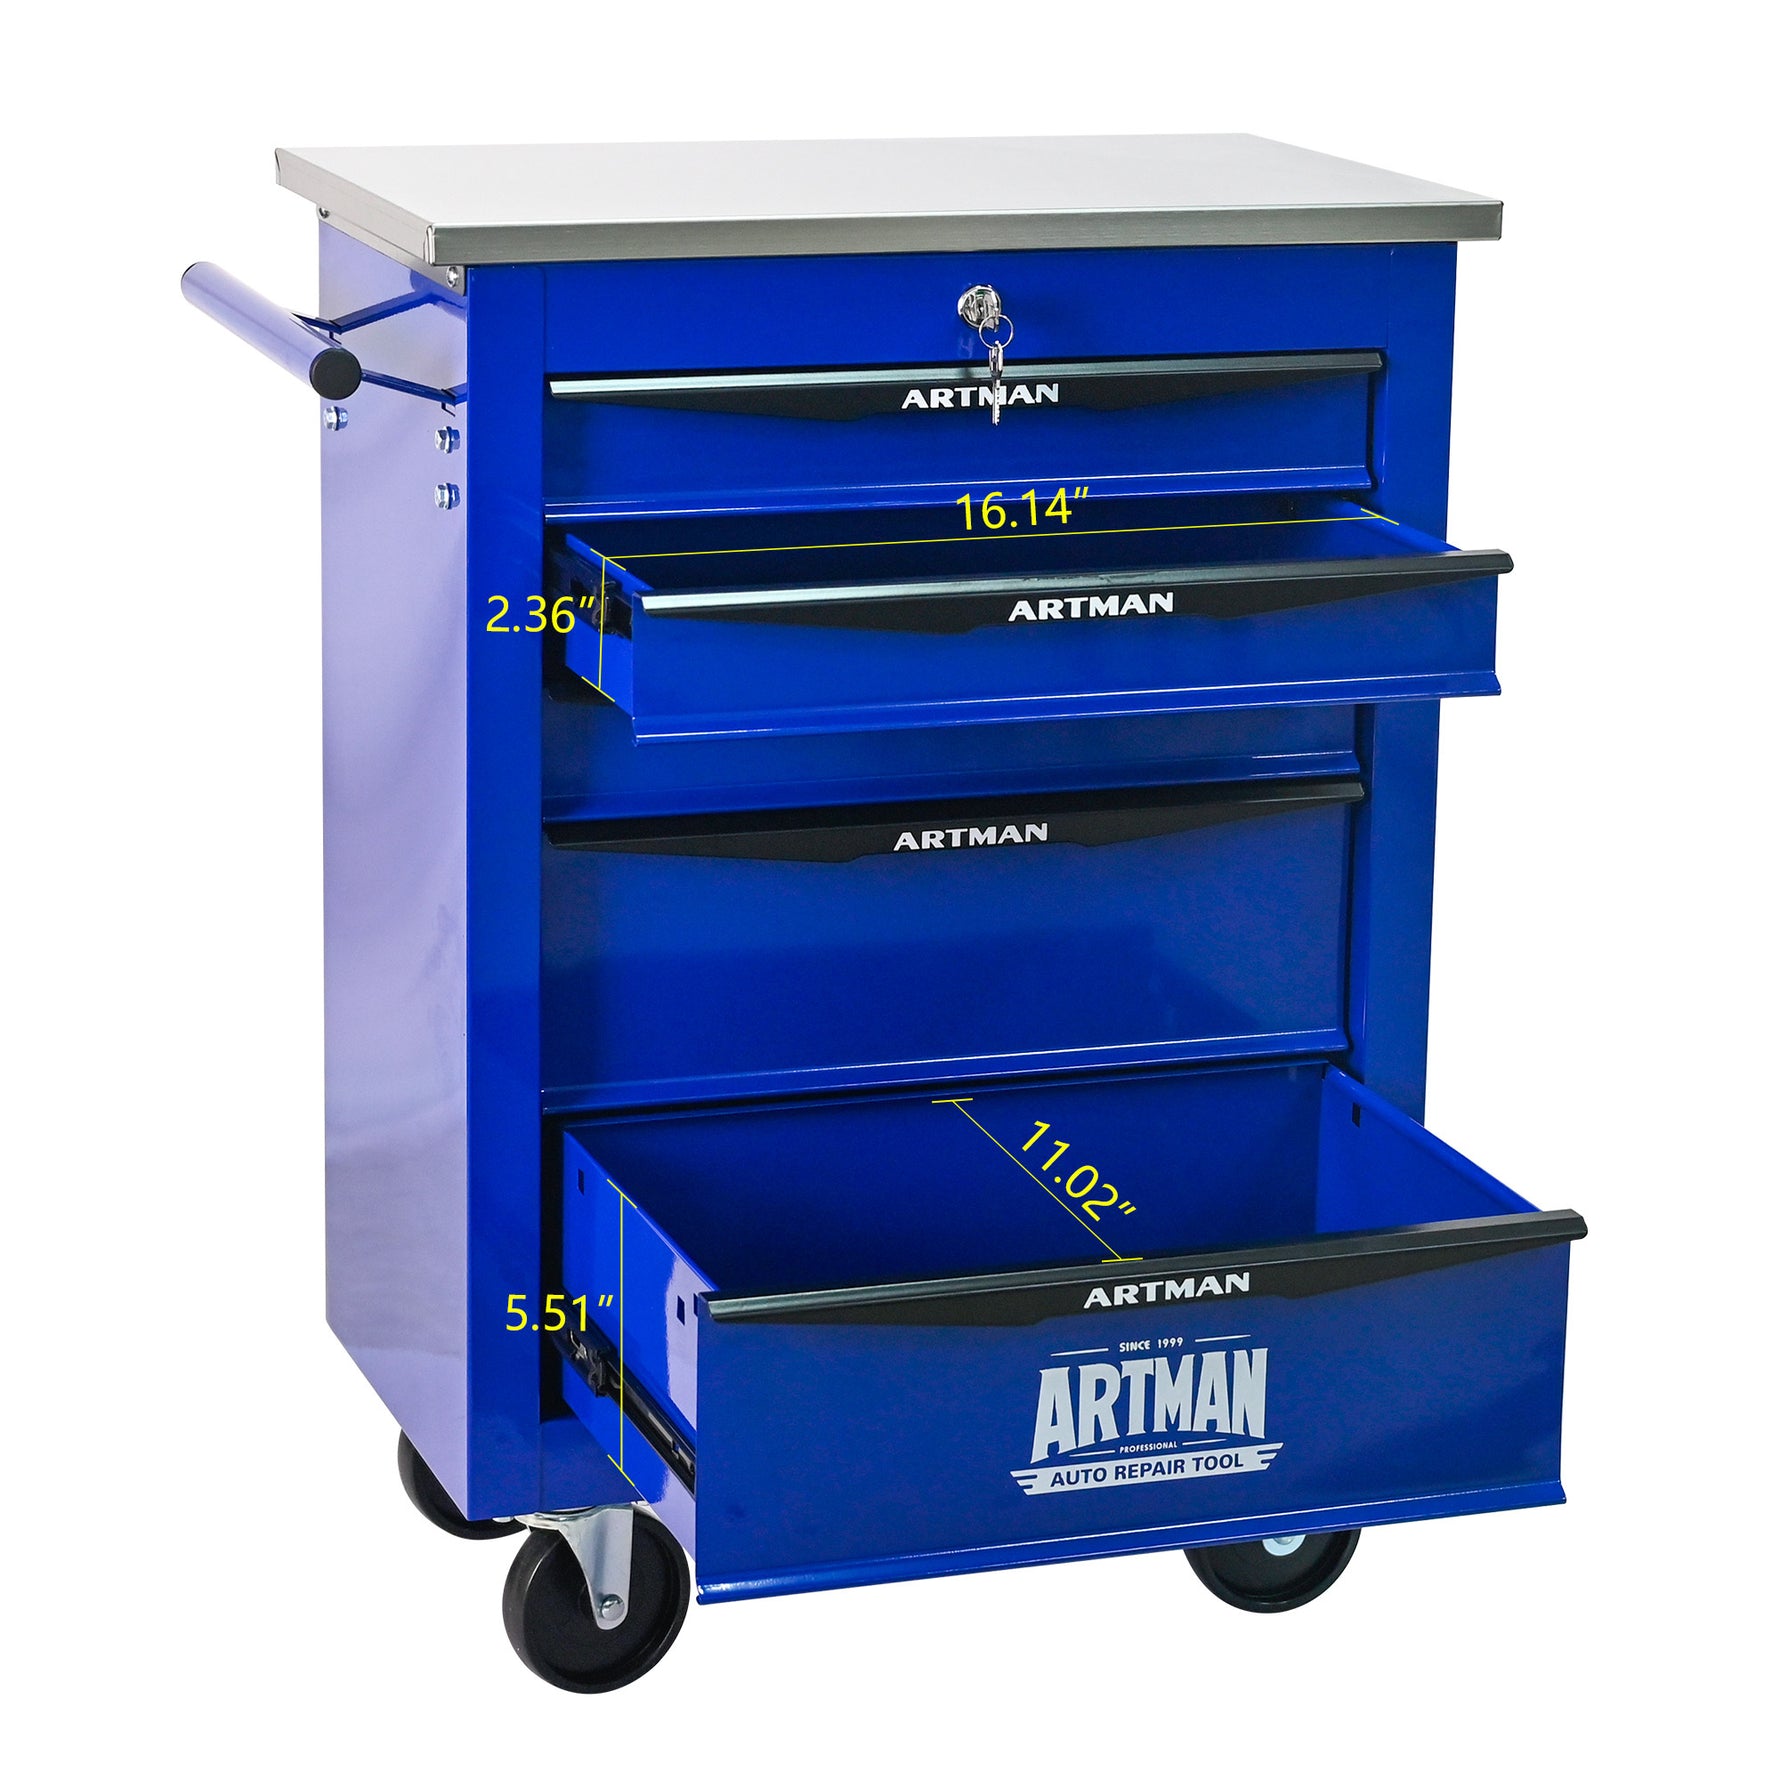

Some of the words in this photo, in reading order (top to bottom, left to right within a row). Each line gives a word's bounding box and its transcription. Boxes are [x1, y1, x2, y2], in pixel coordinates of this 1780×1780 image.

[901, 383, 1059, 409] ARTMAN
[1008, 591, 1174, 622] ARTMAN
[893, 822, 1048, 852] ARTMAN
[1083, 1271, 1250, 1309] ARTMAN
[1119, 1340, 1151, 1353] SINCE
[1157, 1336, 1184, 1349] 1999
[1030, 1347, 1269, 1464] ARTMAN
[1119, 1441, 1178, 1454] PROFESSIONAL
[1050, 1468, 1108, 1488] AUTO
[1114, 1459, 1186, 1480] REPAIR
[1192, 1452, 1244, 1472] TOOL
